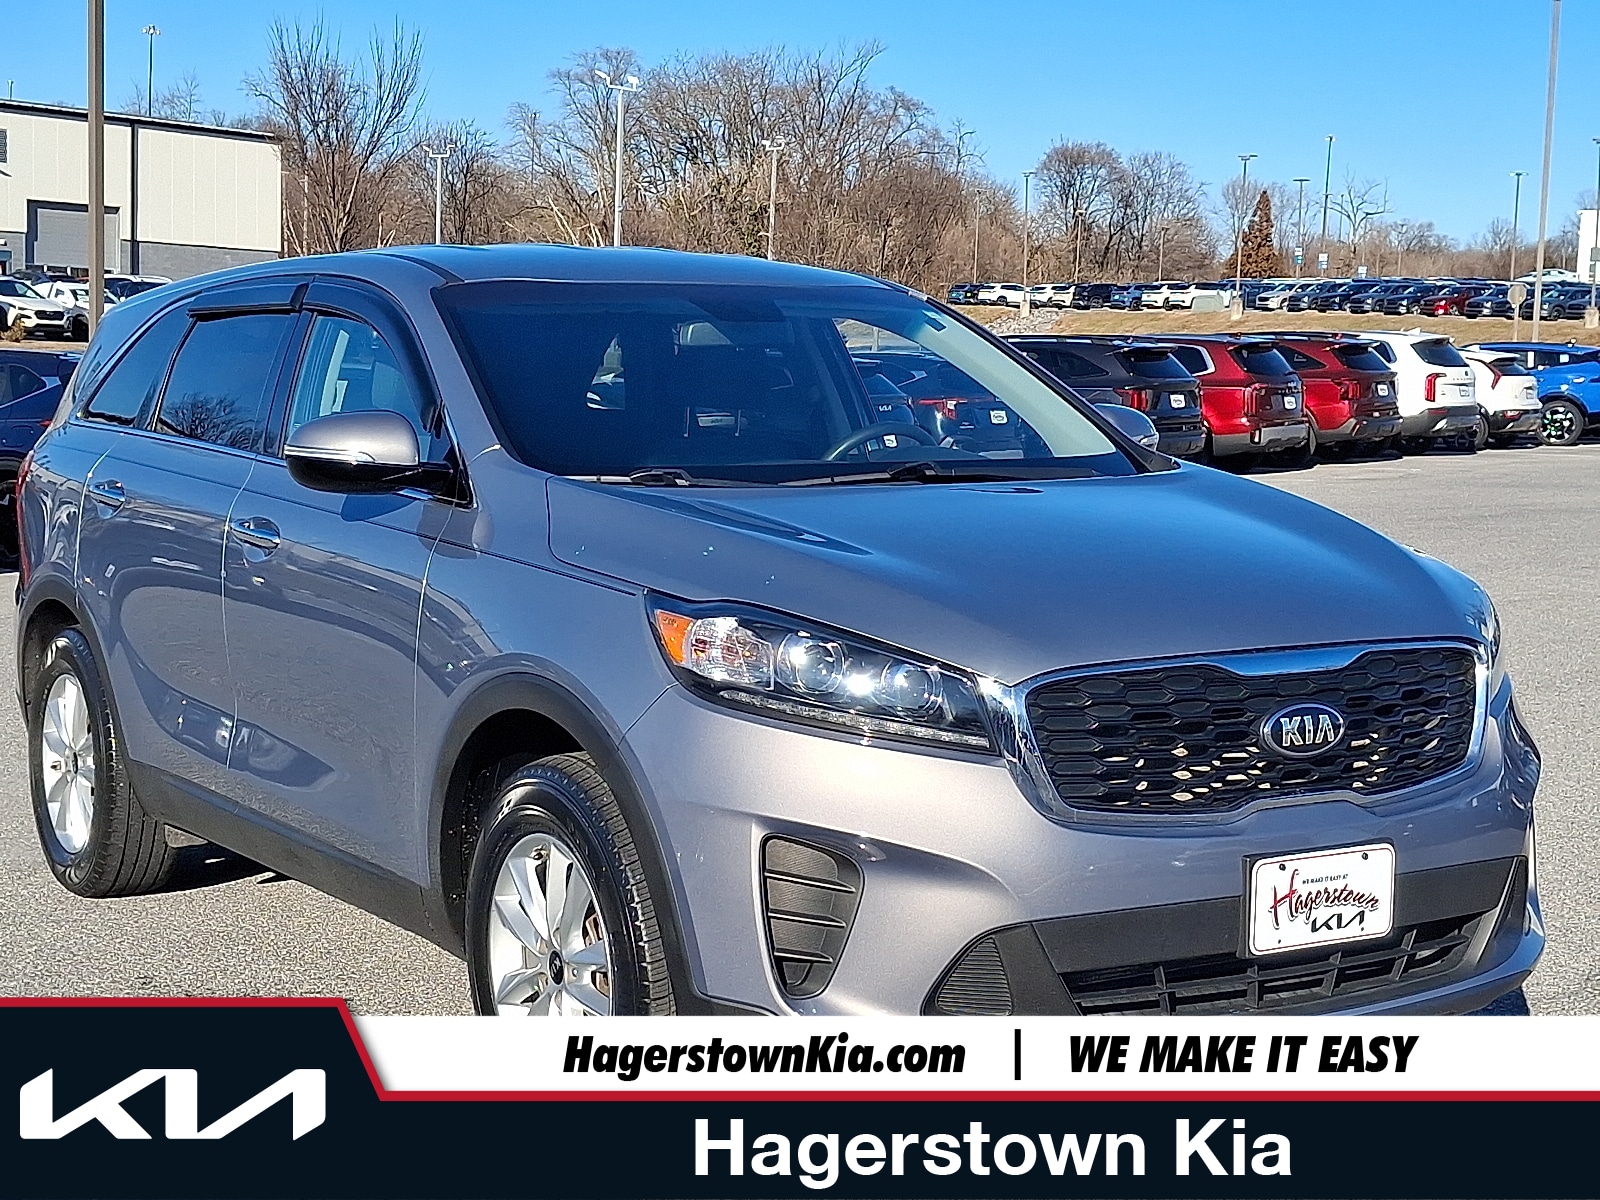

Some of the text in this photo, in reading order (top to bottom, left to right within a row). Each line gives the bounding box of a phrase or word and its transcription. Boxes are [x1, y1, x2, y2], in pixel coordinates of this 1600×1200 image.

[1280, 714, 1335, 747] KIA
[1269, 868, 1380, 930] Hagerstown
[1311, 910, 1365, 933] KIA
